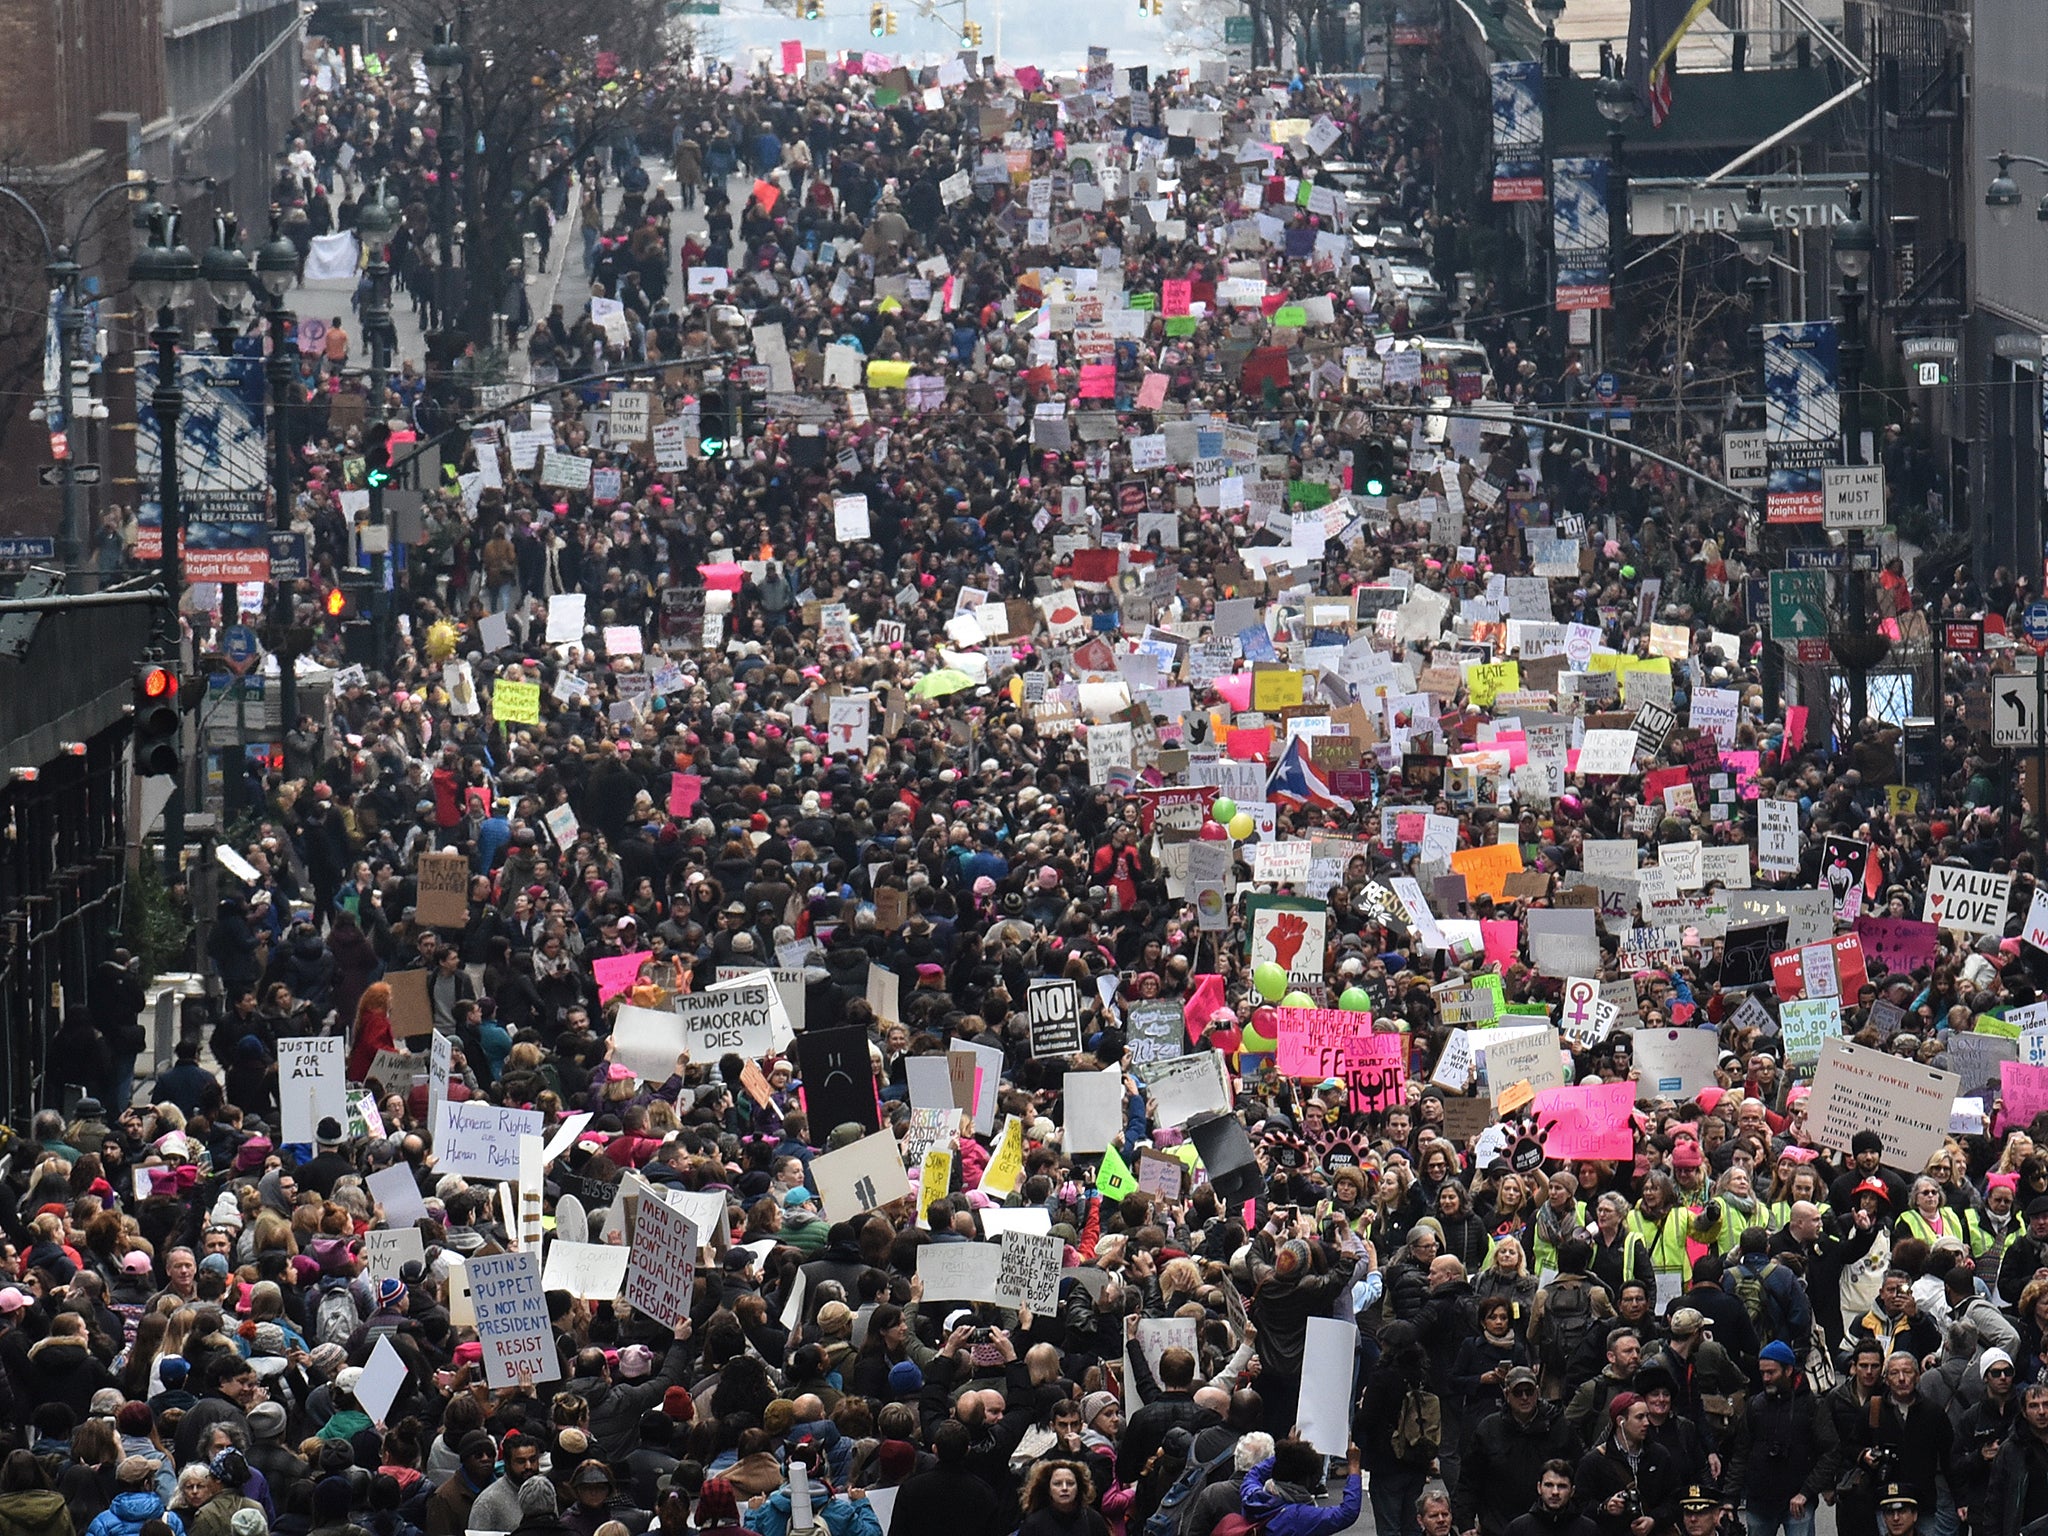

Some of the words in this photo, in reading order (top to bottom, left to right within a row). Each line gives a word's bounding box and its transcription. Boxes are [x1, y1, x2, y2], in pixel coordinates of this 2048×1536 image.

[1668, 203, 1726, 231] THE
[1921, 366, 1936, 382] EAT
[1743, 450, 1761, 459] THE
[1769, 443, 1789, 451] NEW
[1791, 451, 1824, 459] LEADER
[1235, 463, 1256, 476] NOT
[1771, 461, 1781, 469] IN
[1784, 460, 1805, 468] REAL
[1807, 459, 1836, 467] ESTATE
[1828, 475, 1850, 486] LEFT
[1855, 473, 1878, 483] LANE
[1768, 495, 1809, 505] Newmark
[1838, 491, 1869, 503] MUST
[1768, 506, 1797, 516] Knight
[1829, 510, 1853, 520] TURN
[1857, 509, 1879, 519] LEFT
[186, 553, 234, 562] Newmark
[1798, 553, 1837, 566] Third
[186, 564, 219, 576] Knight
[880, 624, 901, 643] NO
[1477, 665, 1505, 679] HATE
[1693, 689, 1719, 697] LOVE
[1638, 703, 1672, 735] NO!
[1692, 707, 1736, 718] TOLERANCE
[1996, 730, 2028, 741] ONLY
[1159, 794, 1203, 805] BATALA
[1764, 801, 1776, 809] THIS
[1780, 802, 1786, 810] IS
[1154, 804, 1200, 819] DUMP
[1259, 842, 1311, 857] JUSTICE
[1460, 855, 1513, 872] HEALTH
[1642, 870, 1663, 881] THIS
[1939, 870, 2009, 900] VALUE
[1944, 898, 1998, 925] LOVE
[1802, 921, 1819, 932] my
[1620, 950, 1670, 969] RESPECT
[677, 992, 729, 1012] TRUMP
[734, 990, 765, 1005] LIES
[1031, 986, 1074, 1023] NO!
[1279, 1007, 1298, 1019] THE
[1350, 1012, 1366, 1024] THE
[2008, 1012, 2022, 1023] not
[2024, 1009, 2036, 1021] my
[1309, 1022, 1360, 1036] OUTWEIGH
[1784, 1018, 1805, 1033] not
[1811, 1020, 1827, 1034] go
[279, 1040, 334, 1053] JUSTICE
[704, 1030, 744, 1049] DIES
[1309, 1034, 1324, 1046] THE
[1303, 1046, 1317, 1056] THE
[1451, 1054, 1471, 1065] WITH
[295, 1055, 320, 1066] FOR
[1358, 1058, 1384, 1067] BUILT
[1388, 1056, 1400, 1066] ON
[1450, 1061, 1464, 1071] HER
[291, 1067, 324, 1079] ALL
[1832, 1059, 1874, 1078] WOMAN'S
[1878, 1074, 1910, 1090] POWER
[1915, 1086, 1944, 1100] POSSE
[1611, 1088, 1627, 1106] Go
[1834, 1083, 1852, 1095] PRO
[1857, 1091, 1892, 1108] CHOICE
[912, 1109, 951, 1127] RESPECT
[1828, 1104, 1858, 1119] EQUAL
[1864, 1114, 1883, 1127] PAY
[1831, 1094, 1890, 1118] AFFORDABLE
[1895, 1115, 1933, 1132] HEALTH
[499, 1110, 532, 1137] Rights
[1826, 1114, 1859, 1131] VOTING
[1820, 1136, 1844, 1149] LGBT
[445, 1139, 477, 1162] Human
[488, 1144, 520, 1167] Rights
[1330, 1154, 1352, 1163] PUSSY
[643, 1200, 668, 1226] MEN
[674, 1219, 690, 1239] OF
[638, 1217, 687, 1256] QUALITY
[1005, 1231, 1018, 1243] NO
[1025, 1234, 1054, 1248] WOMAN
[1009, 1243, 1026, 1255] CAN
[1032, 1247, 1056, 1260] CALL
[472, 1257, 528, 1279] PUTIN'S
[665, 1250, 693, 1281] FEAR
[1002, 1253, 1036, 1267] HERSELF
[1040, 1259, 1059, 1272] FREE
[631, 1250, 690, 1297] EQUALITY
[1001, 1264, 1017, 1274] WHO
[1020, 1266, 1039, 1280] DOES
[1043, 1270, 1059, 1282] NOT
[475, 1276, 533, 1300] PUPPET
[637, 1274, 657, 1295] NOT
[664, 1290, 681, 1309] MY
[1000, 1273, 1032, 1289] CONTROL
[1037, 1282, 1055, 1293] HER
[1002, 1285, 1021, 1297] OWN
[1028, 1290, 1050, 1303] BODY
[476, 1305, 489, 1318] IS
[495, 1300, 517, 1315] NOT
[523, 1296, 541, 1311] MY
[630, 1284, 687, 1327] PRESIDENT
[477, 1315, 548, 1337] PRESIDENT
[496, 1336, 542, 1357] RESIST
[505, 1357, 544, 1378] BIGLY
